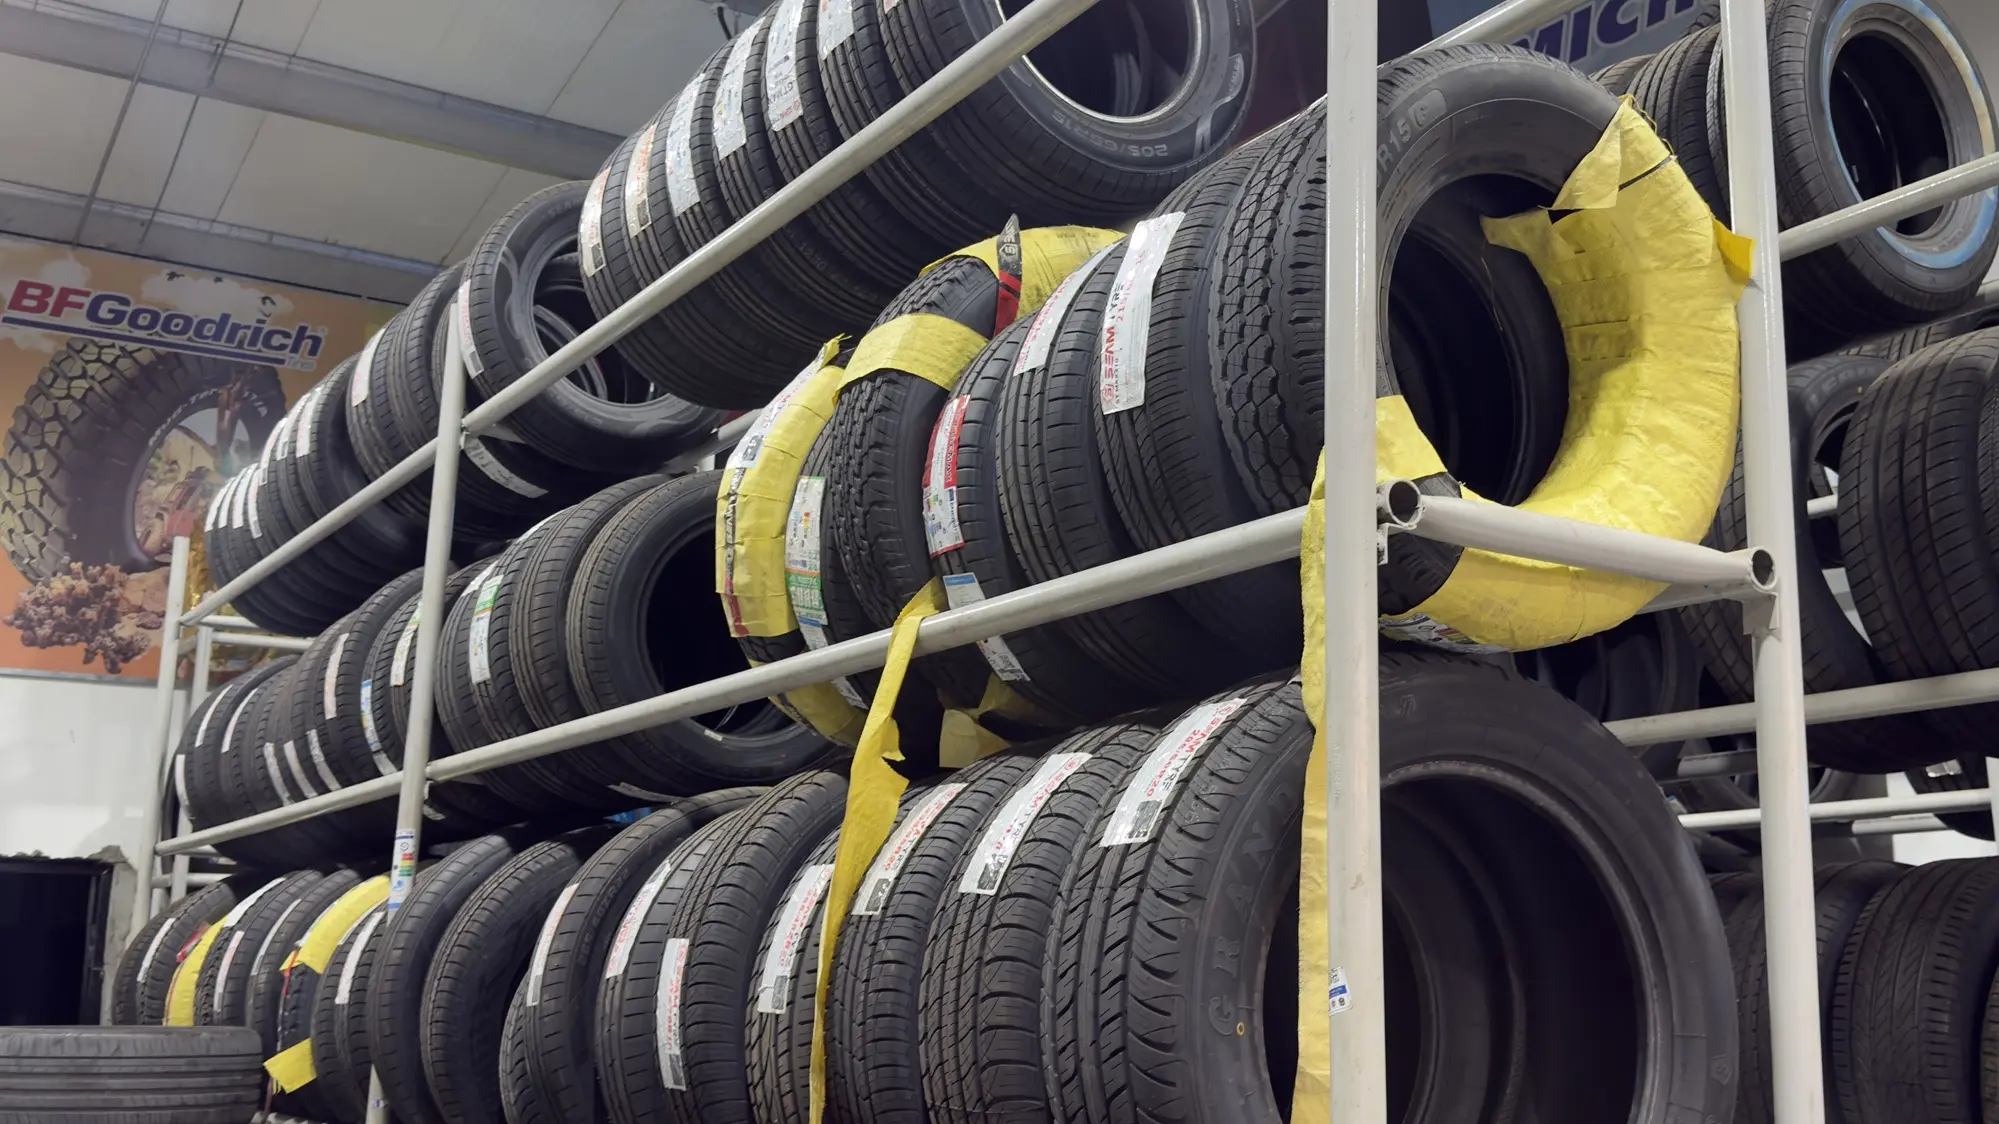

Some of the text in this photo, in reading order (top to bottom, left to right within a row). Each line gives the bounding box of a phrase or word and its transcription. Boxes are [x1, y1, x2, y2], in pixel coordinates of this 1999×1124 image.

[1050, 109, 1167, 156] 205/65R15
[7, 279, 324, 357] BFGoodrich
[1103, 325, 1116, 379] SEAM
[1161, 717, 1221, 792] SEAM TYRE
[1208, 784, 1300, 1037] GRAND
